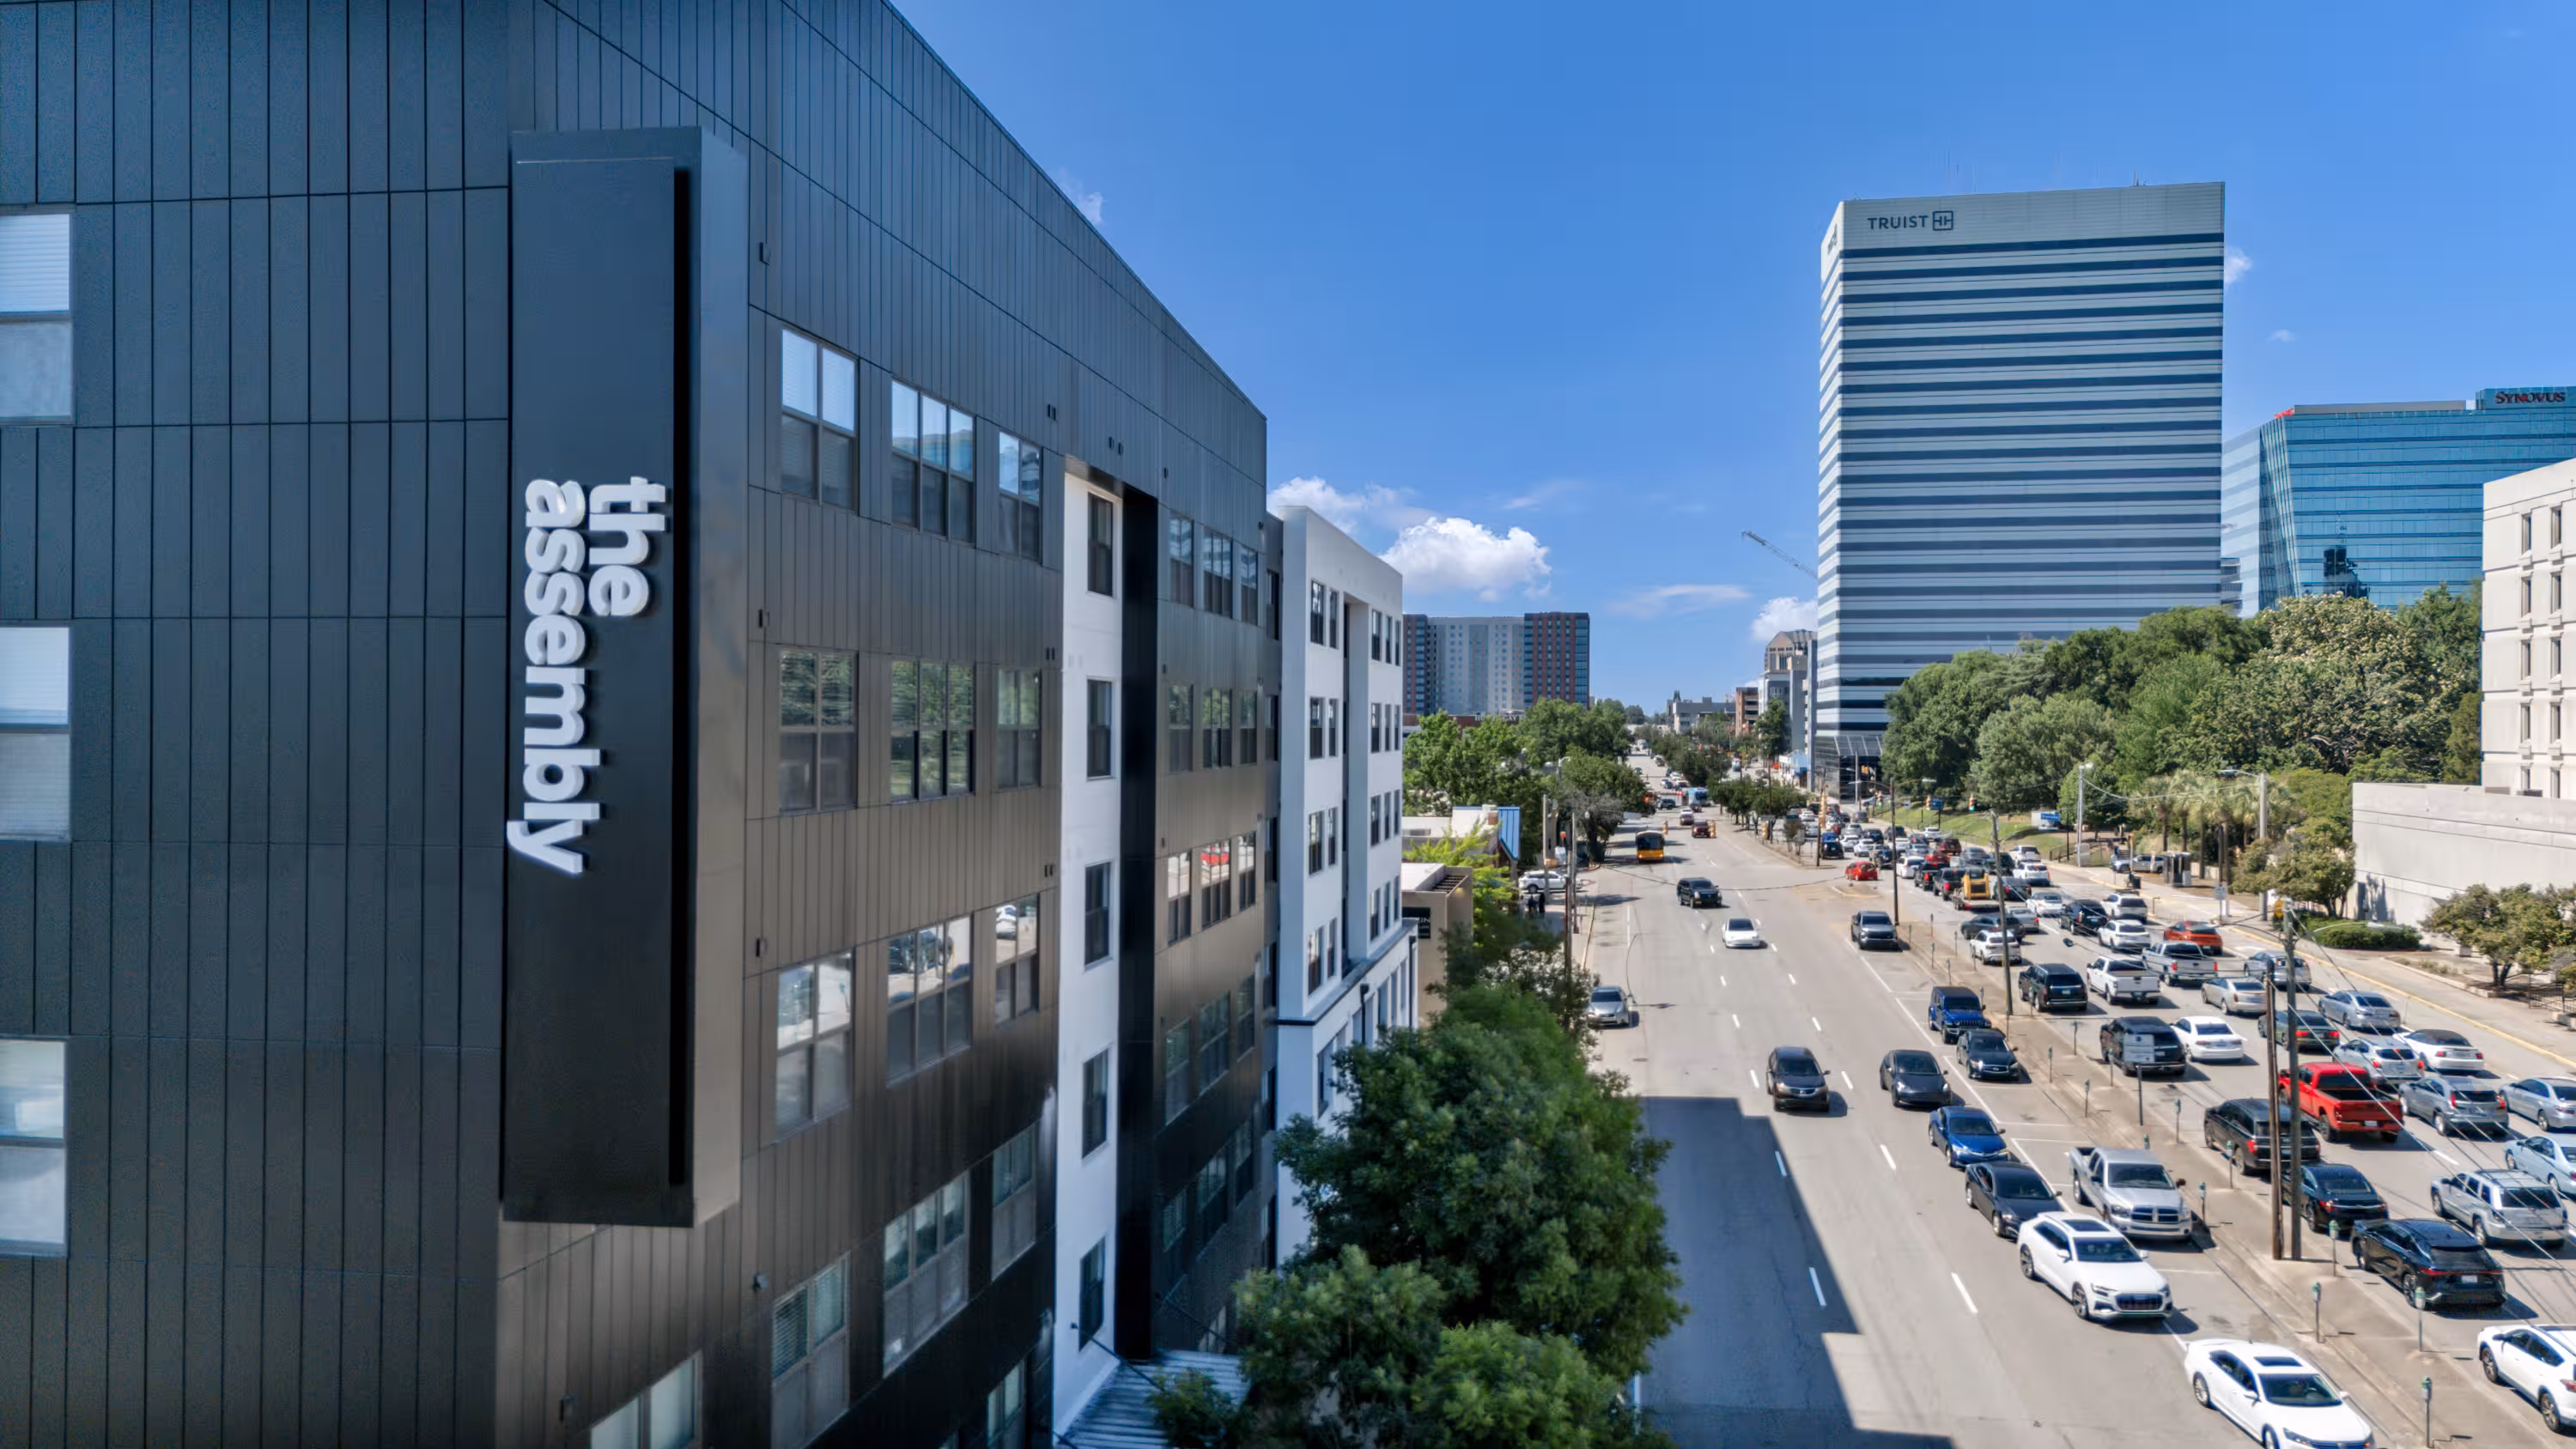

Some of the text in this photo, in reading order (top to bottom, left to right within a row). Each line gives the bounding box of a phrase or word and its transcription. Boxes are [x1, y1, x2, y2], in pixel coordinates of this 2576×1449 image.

[1867, 215, 1929, 230] TRUIST
[2495, 391, 2566, 404] SYNOVUS
[589, 476, 665, 616] the
[507, 479, 600, 875] assembly
